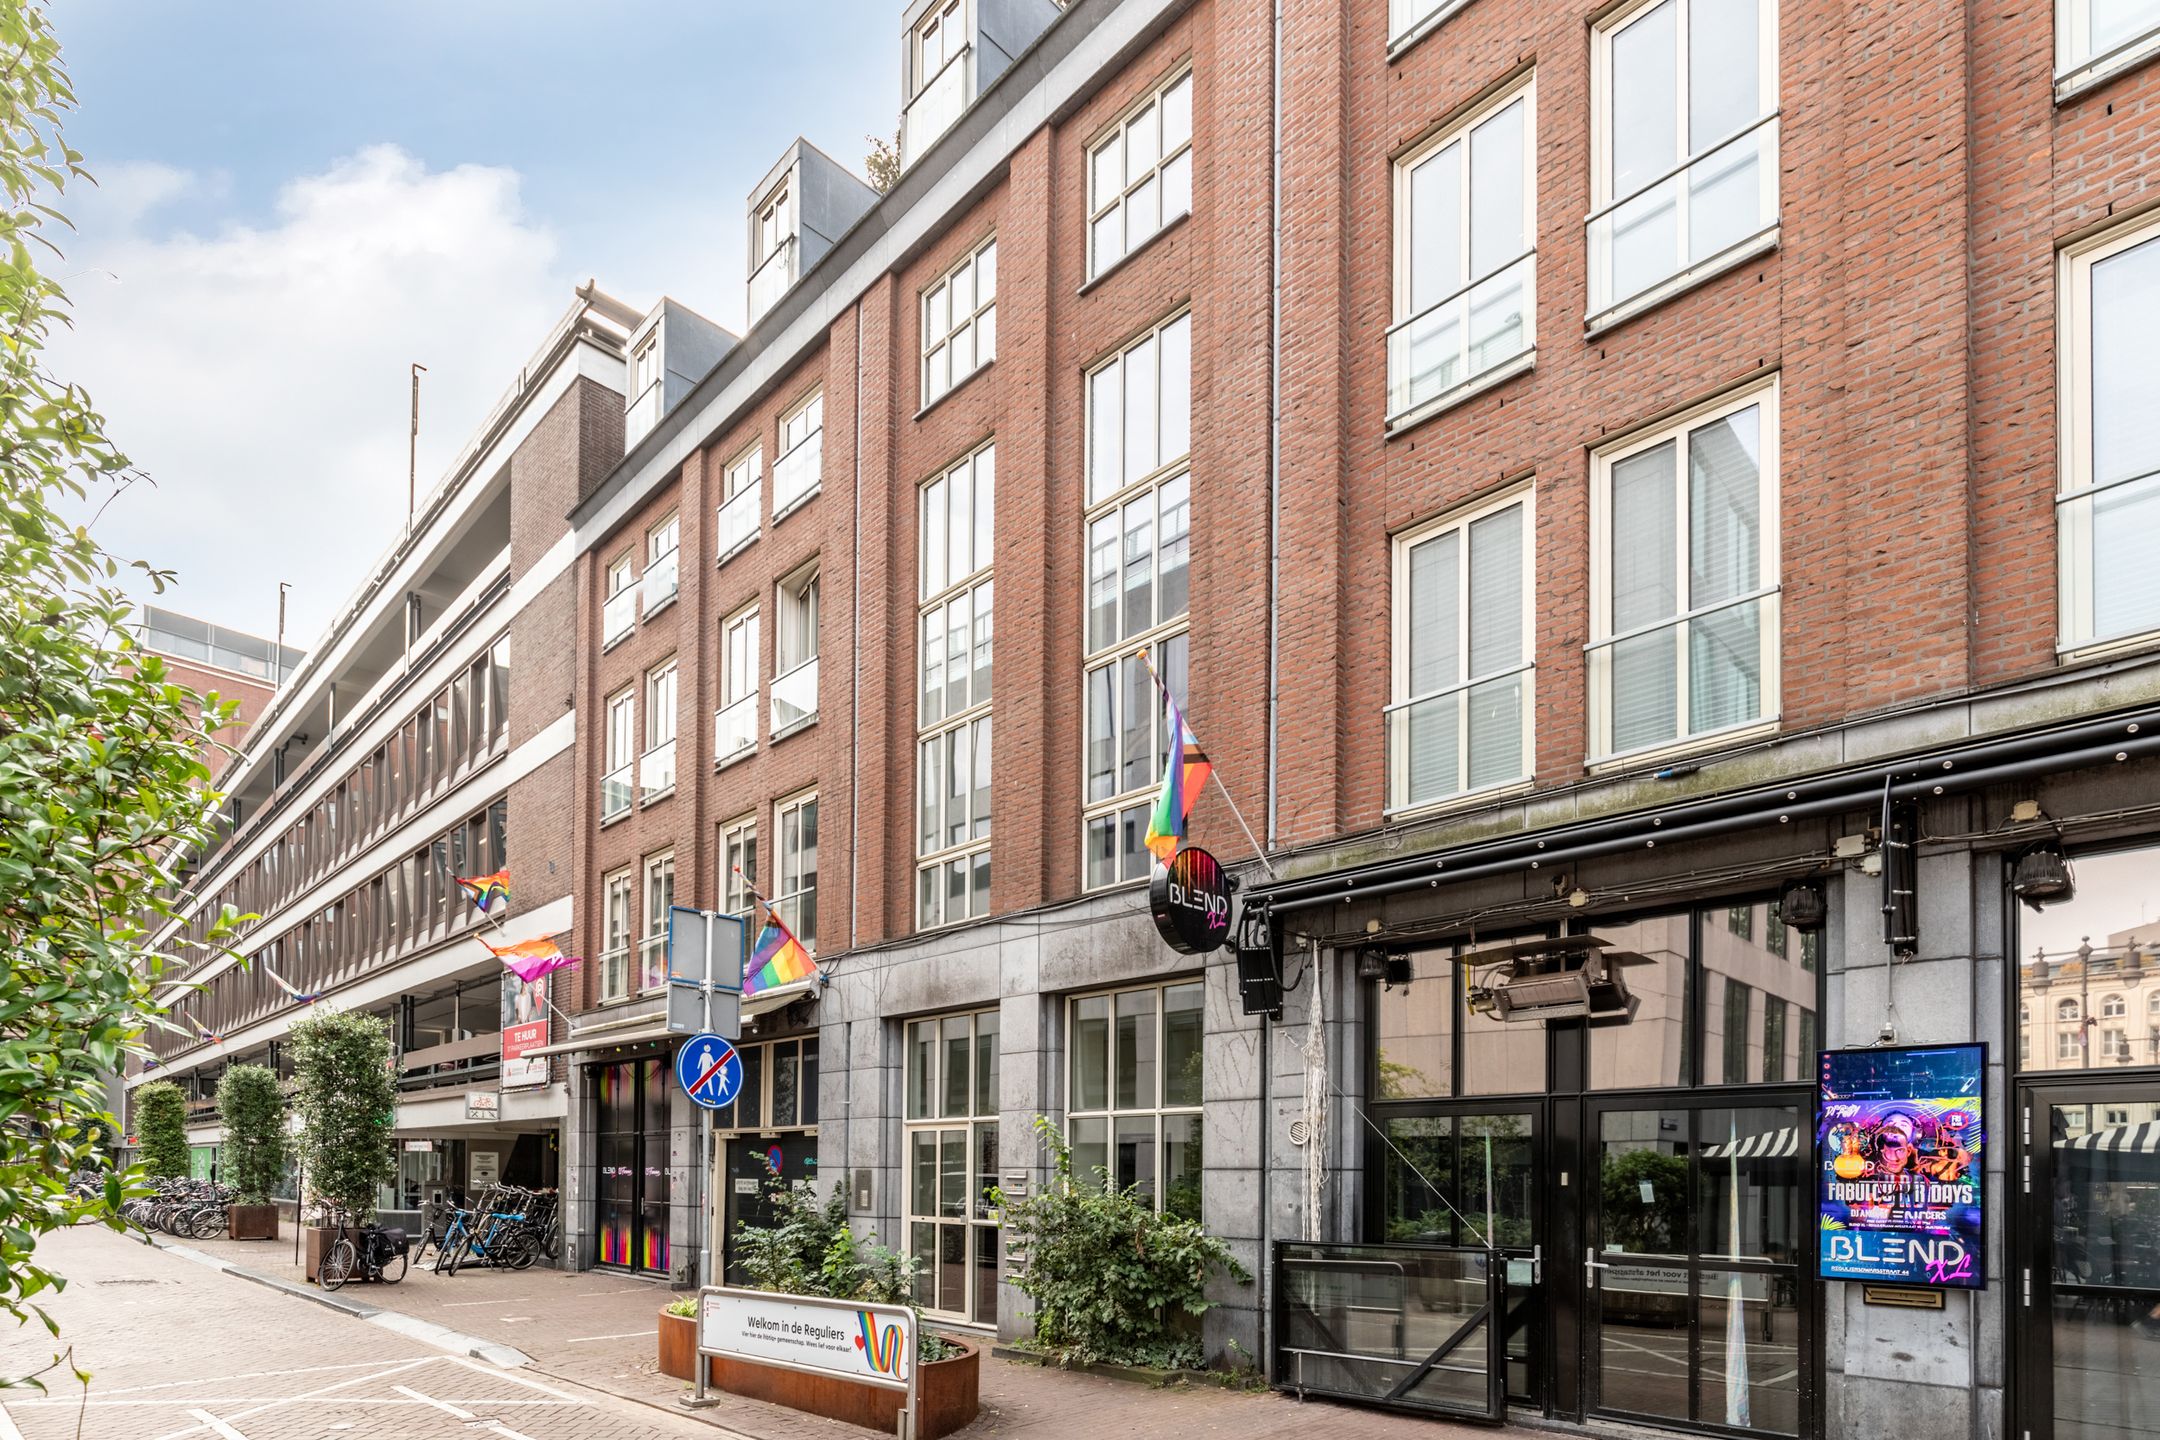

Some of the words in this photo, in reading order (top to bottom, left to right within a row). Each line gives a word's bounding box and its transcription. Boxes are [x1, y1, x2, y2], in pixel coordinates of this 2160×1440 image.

[1170, 883, 1228, 915] BLEND
[514, 1032, 521, 1043] TE
[521, 1028, 537, 1042] HUUR
[1830, 1235, 1965, 1266] BLEND
[1924, 1253, 1974, 1284] XL
[747, 1316, 780, 1333] Welkom
[781, 1320, 789, 1333] in
[791, 1321, 802, 1336] de
[804, 1324, 845, 1342] Reguliers
